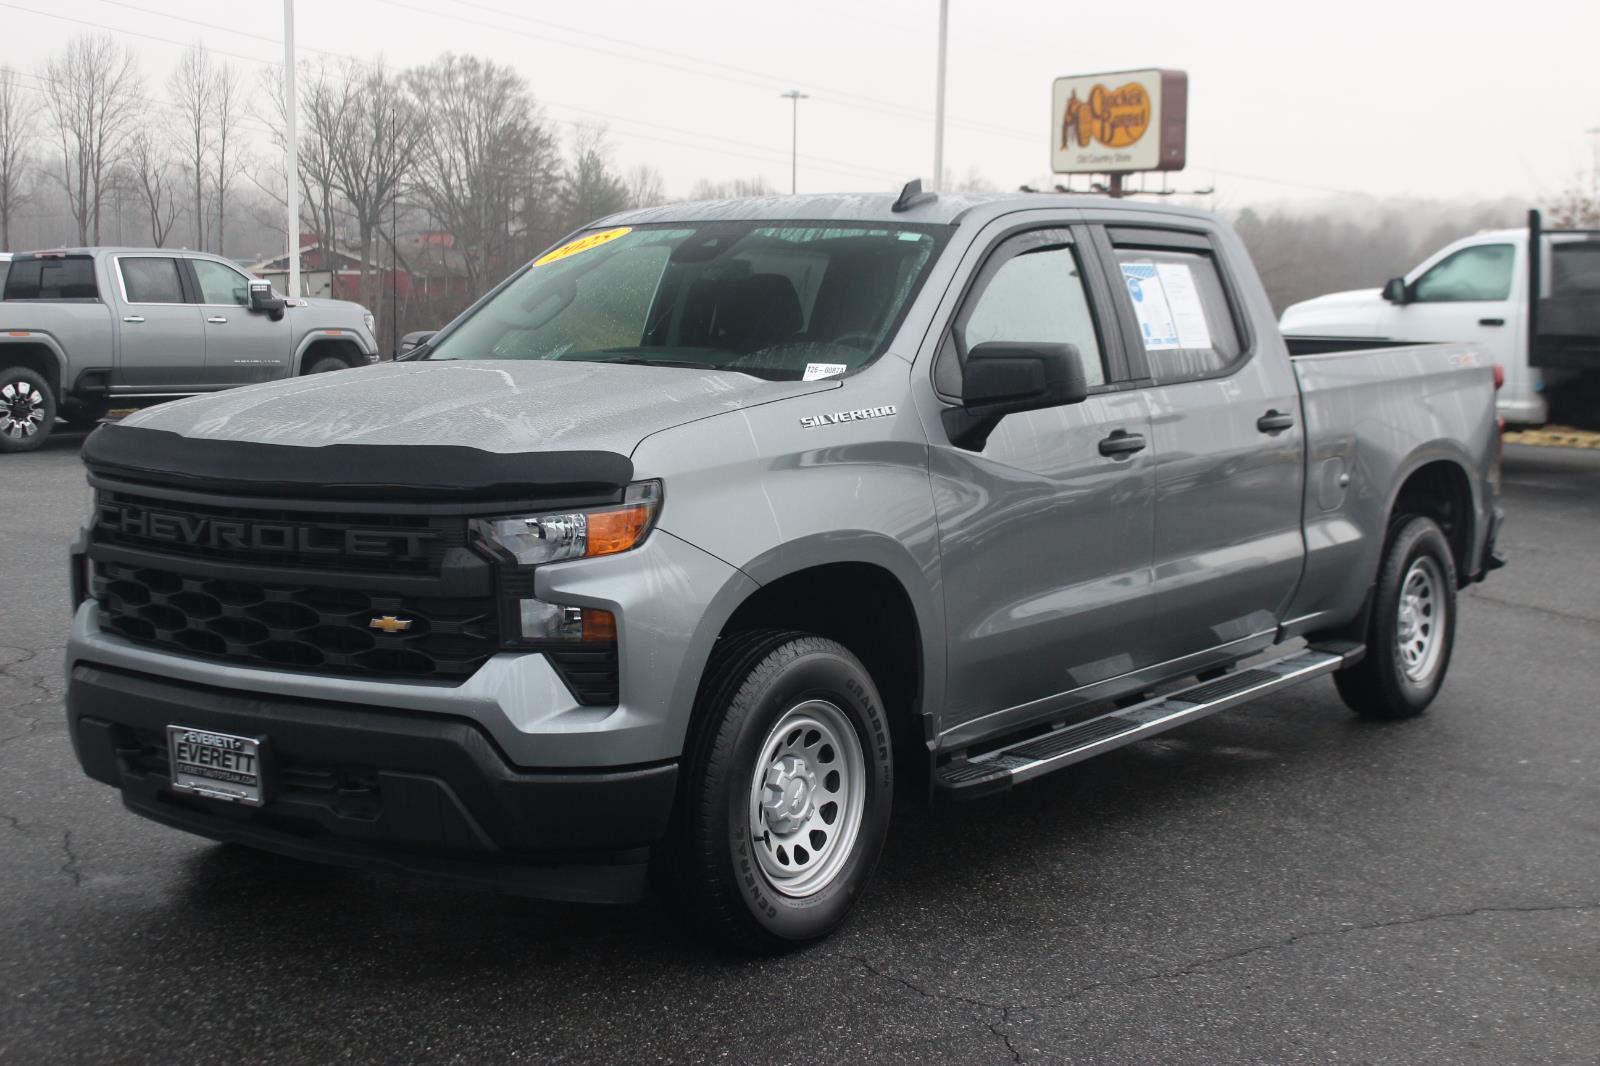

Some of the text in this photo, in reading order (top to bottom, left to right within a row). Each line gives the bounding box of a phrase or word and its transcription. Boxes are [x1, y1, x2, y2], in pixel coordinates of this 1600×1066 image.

[800, 405, 897, 428] SILVERADO
[97, 503, 442, 558] CHEVROLET
[846, 678, 889, 762] GRABBER
[177, 742, 256, 773] EVERETT
[736, 826, 778, 920] GENERAL
